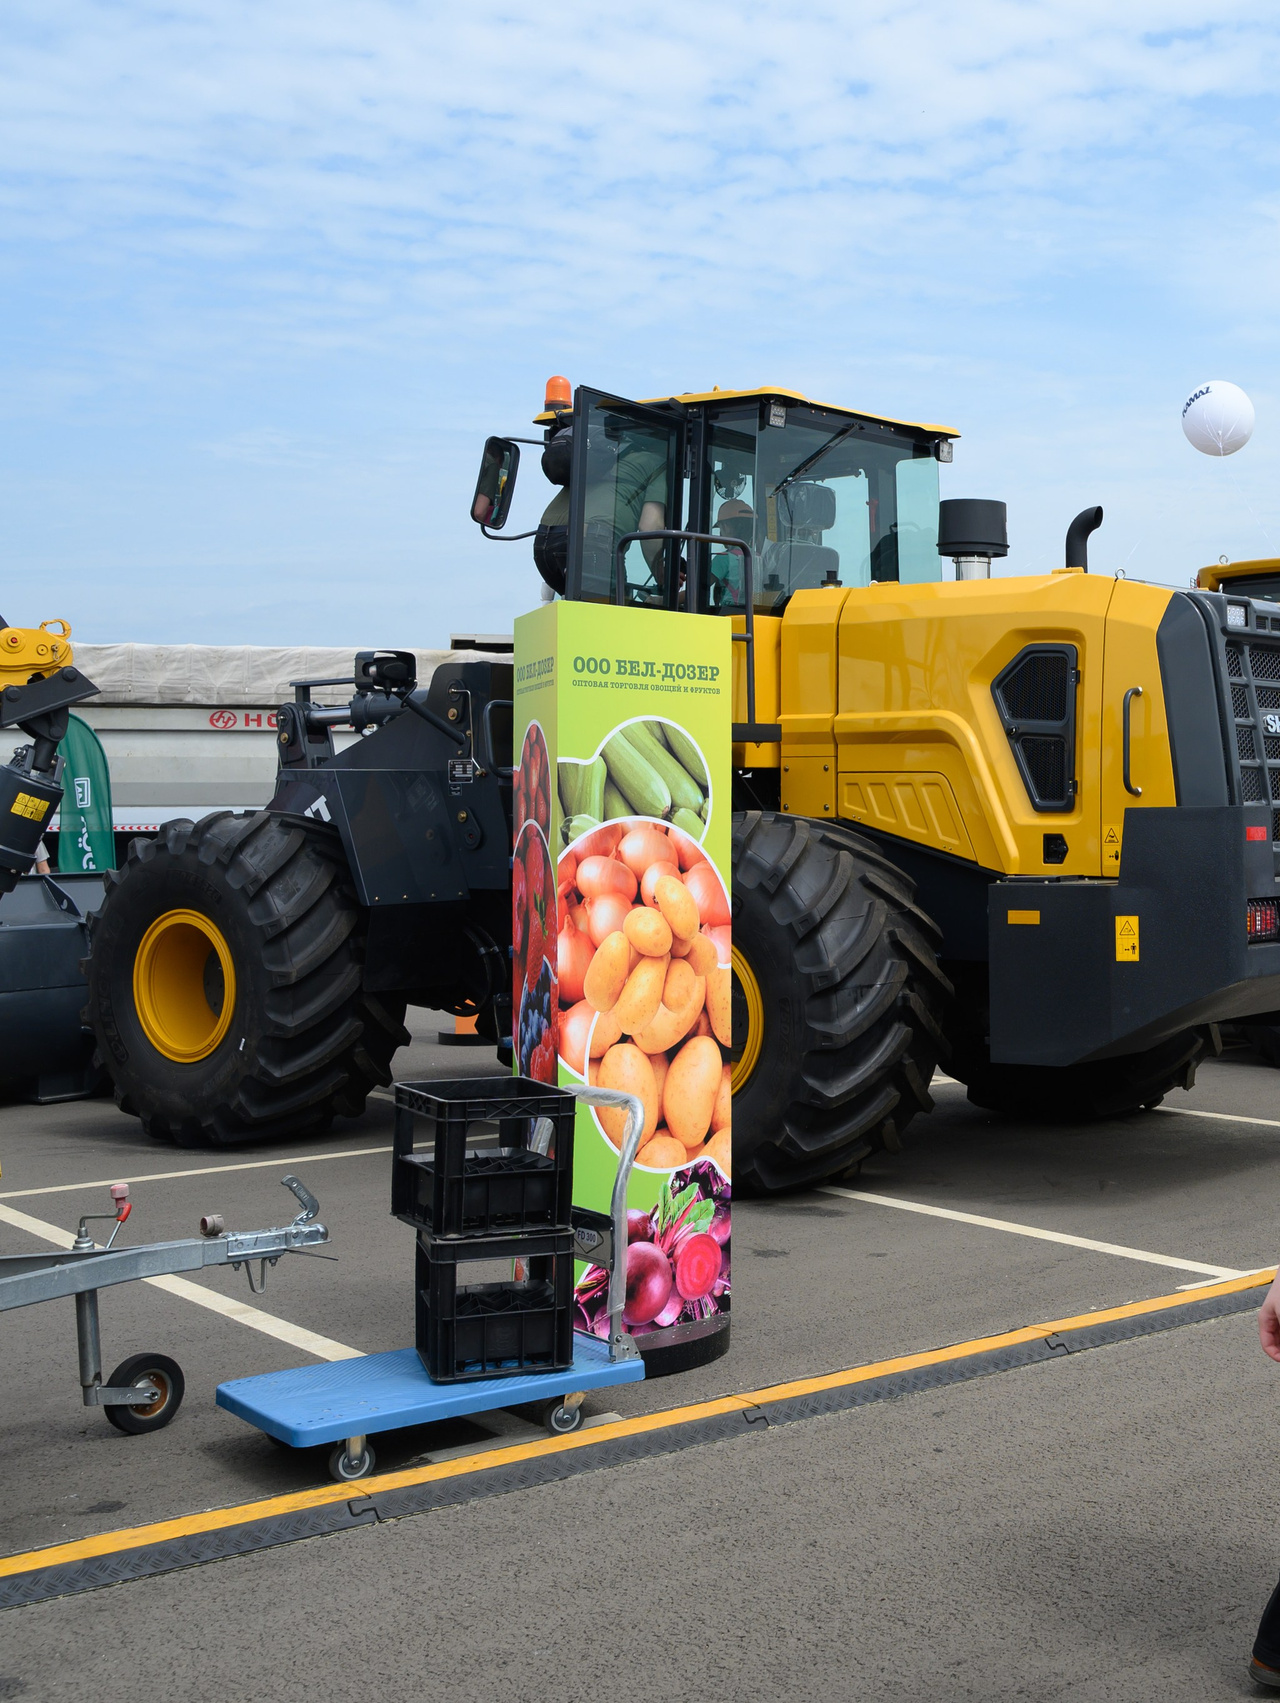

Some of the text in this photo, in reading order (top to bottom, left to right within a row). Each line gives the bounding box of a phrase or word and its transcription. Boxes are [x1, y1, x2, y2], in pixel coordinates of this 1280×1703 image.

[573, 656, 720, 682] ООО БЕЛ-ДОЗЕР
[572, 679, 609, 688] ОПТОВАЯ
[610, 682, 649, 691] ТОРГОВЛЯ
[650, 683, 682, 693] ОВОЩЕЙ
[690, 686, 721, 695] ФРУКТОВ
[577, 1231, 596, 1243] FD 300
